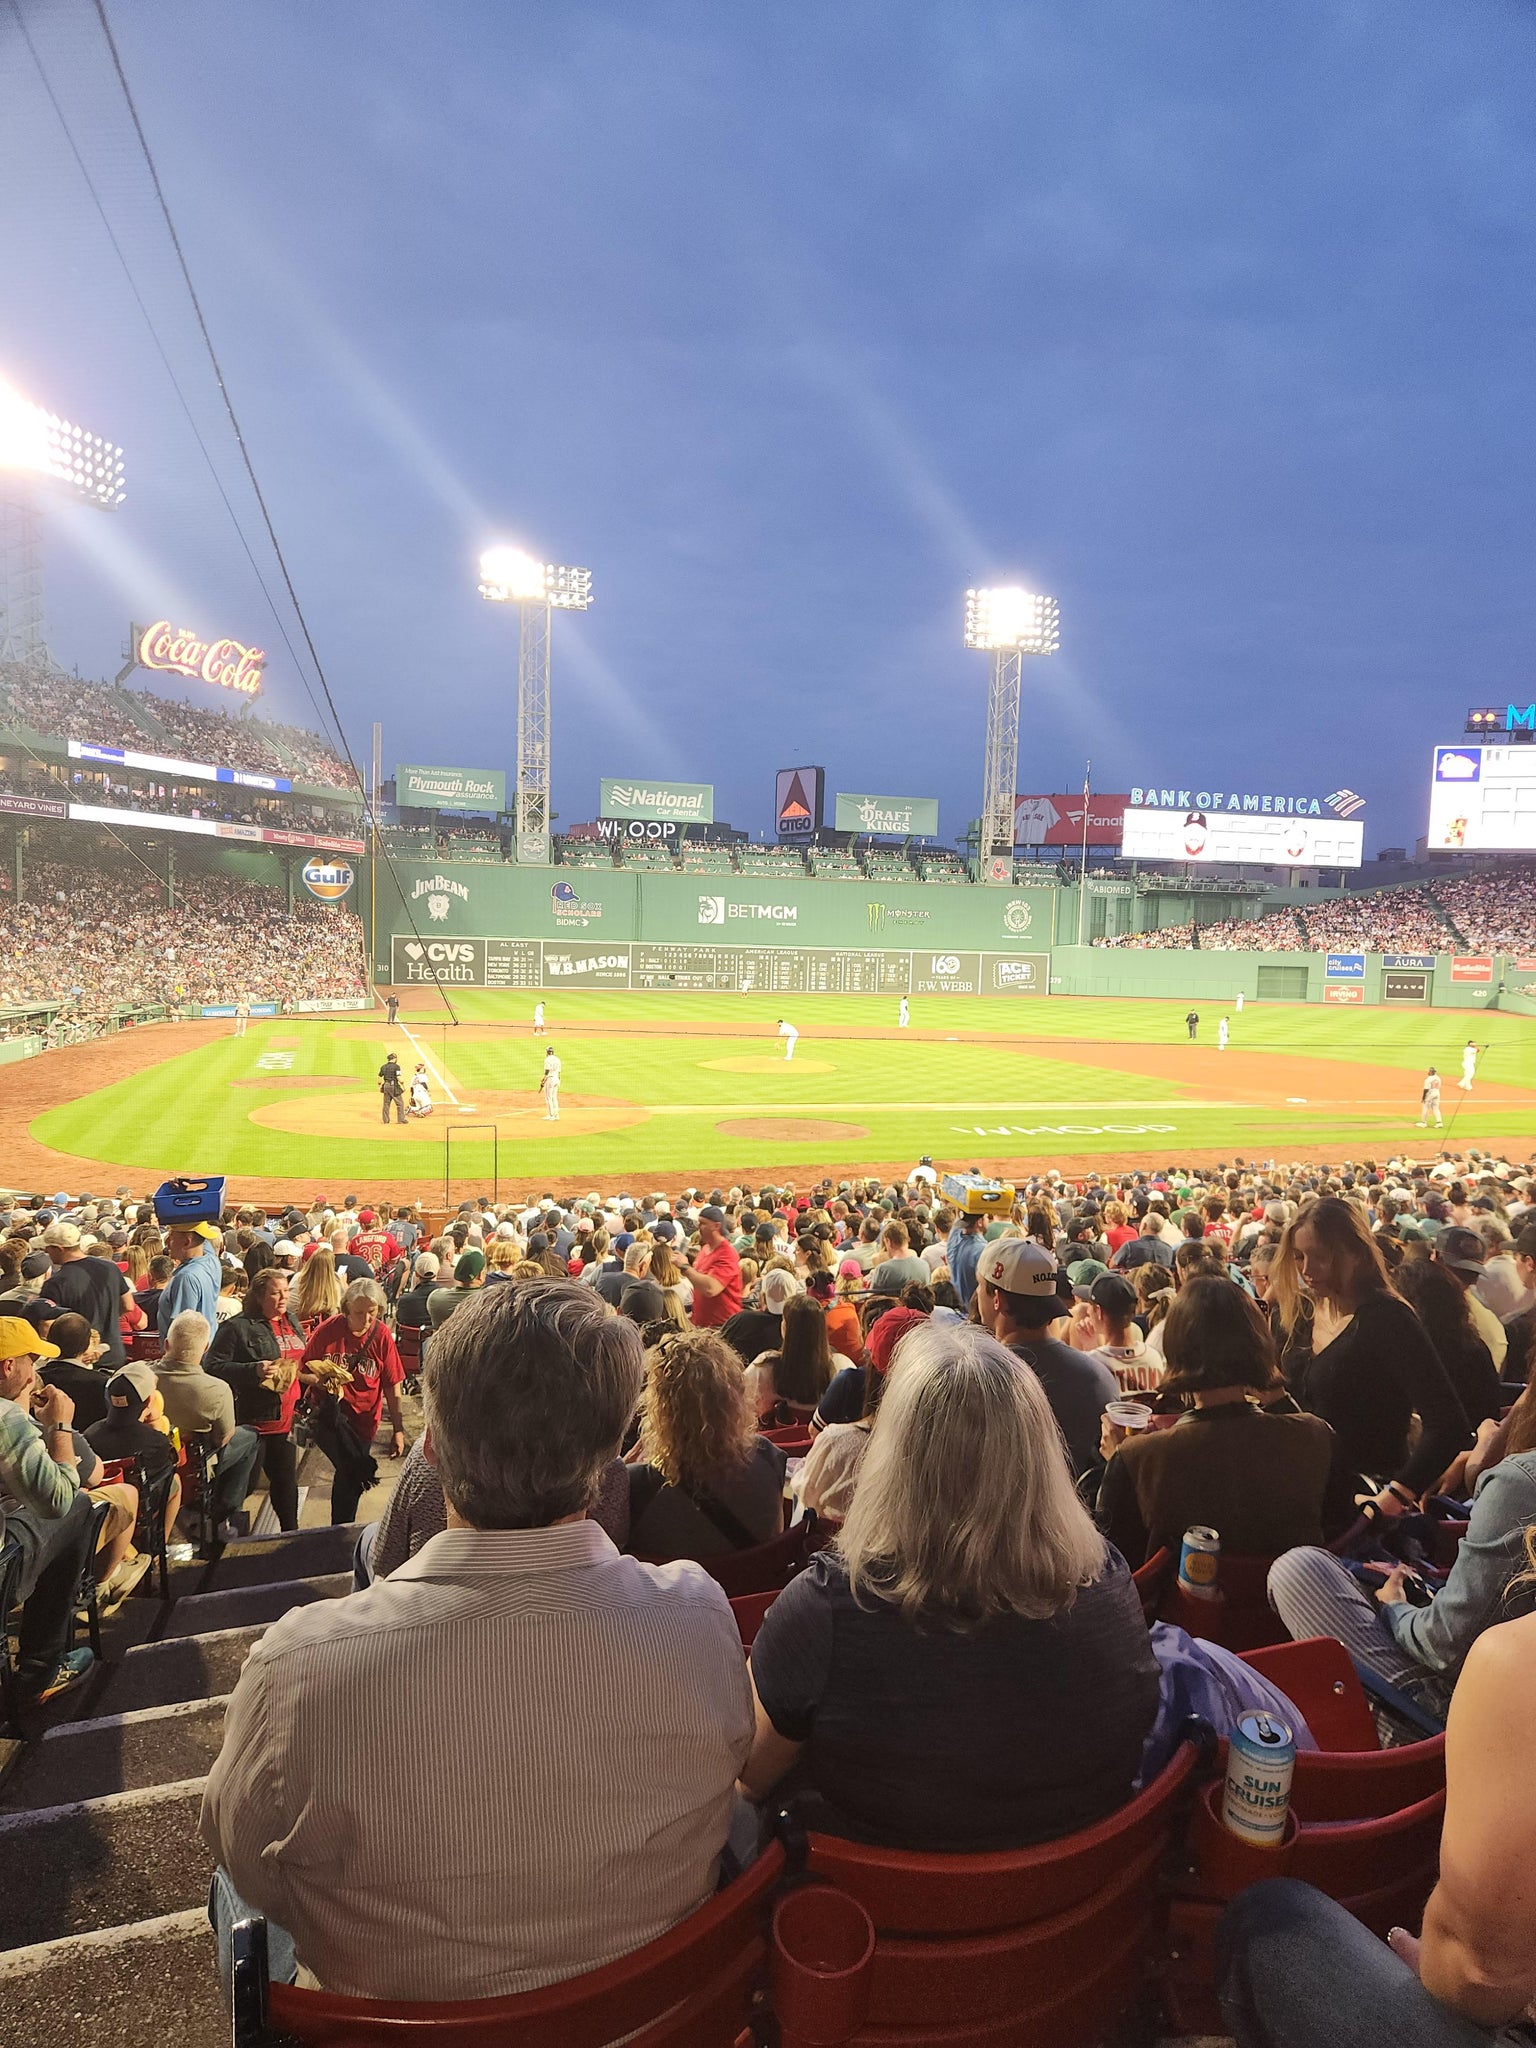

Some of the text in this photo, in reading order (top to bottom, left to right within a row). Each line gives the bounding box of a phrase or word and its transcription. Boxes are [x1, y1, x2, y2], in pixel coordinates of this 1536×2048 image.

[141, 621, 266, 693] Coca-Cola
[408, 776, 494, 794] Plymouth Rock
[632, 790, 702, 808] National
[1131, 788, 1321, 814] BANK OF AMERICA
[39, 803, 62, 813] VINES
[860, 809, 912, 822] DRAFT
[780, 818, 811, 832] CITGO
[866, 821, 910, 832] KINGS
[305, 869, 350, 884] Gulf
[1094, 886, 1131, 894] ABIOMED
[557, 901, 602, 910] RED SOX
[728, 904, 797, 919] BETMGM
[888, 909, 930, 918] MONSTER
[428, 943, 474, 962] CVS
[377, 964, 389, 972] 310
[407, 963, 474, 981] Health
[931, 956, 960, 974] 160
[1002, 962, 1031, 975] ACE
[1001, 973, 1031, 983] TICKET
[918, 981, 973, 992] F.W. WEBB
[356, 1235, 387, 1246] LANGFORD
[359, 1244, 382, 1264] 36
[992, 1261, 1004, 1280] B
[1243, 1775, 1281, 1793] SUN
